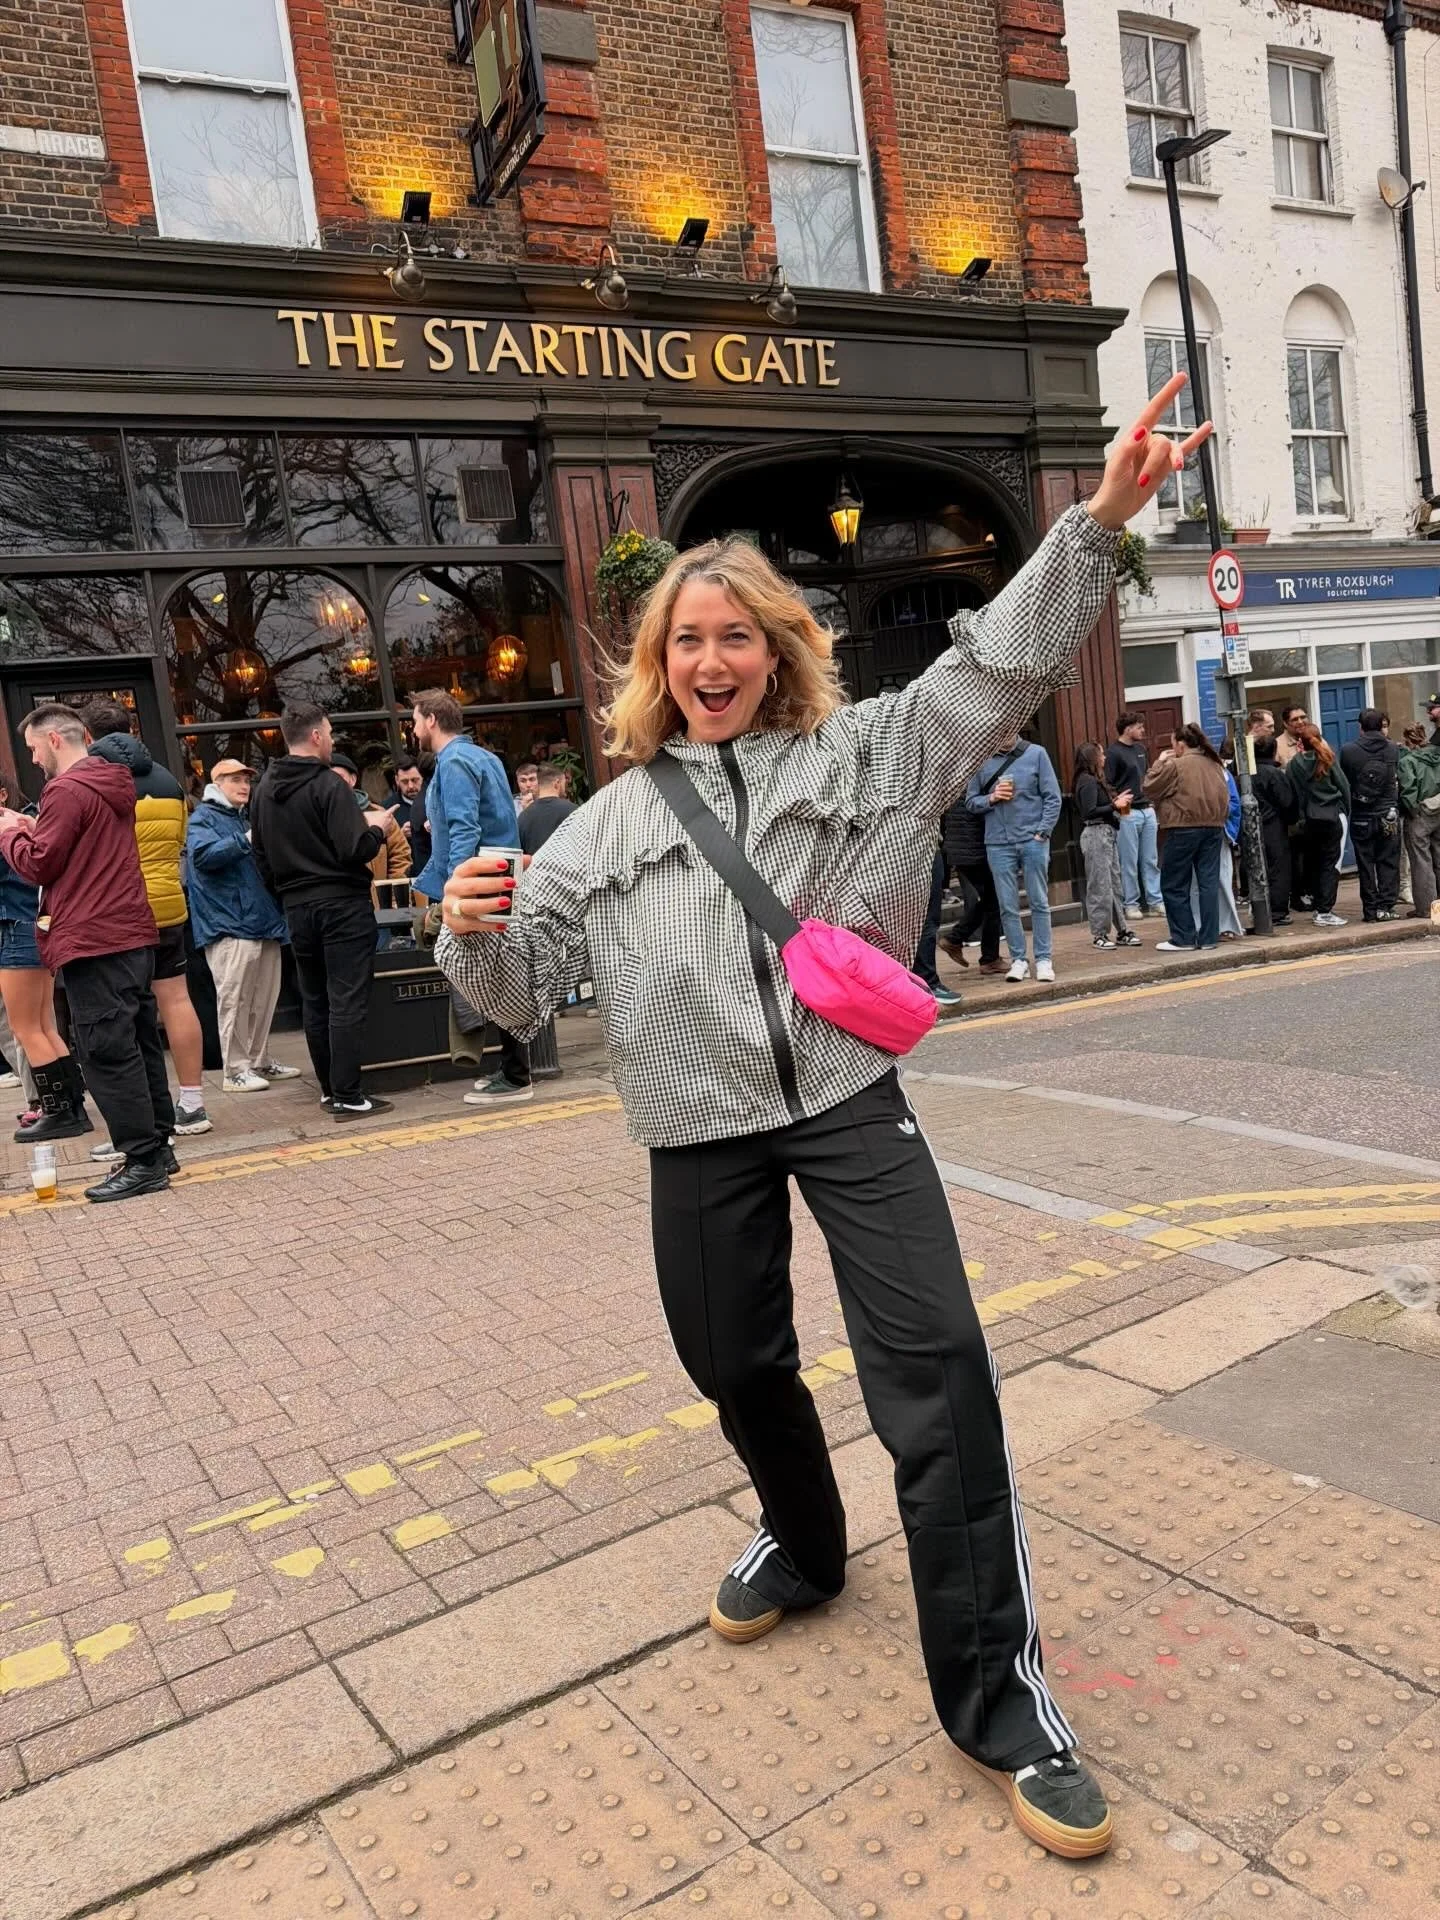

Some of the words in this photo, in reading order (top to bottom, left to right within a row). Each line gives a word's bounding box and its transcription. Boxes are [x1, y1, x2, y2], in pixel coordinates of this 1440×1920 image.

[277, 309, 404, 371] THE
[423, 317, 697, 381] STARTING
[713, 333, 841, 387] GATE
[1214, 566, 1239, 592] 20
[1298, 576, 1332, 588] TYRER
[1336, 574, 1395, 587] ROXBURGH
[1327, 588, 1367, 597] SOLICITORS
[397, 981, 450, 998] LITTER
